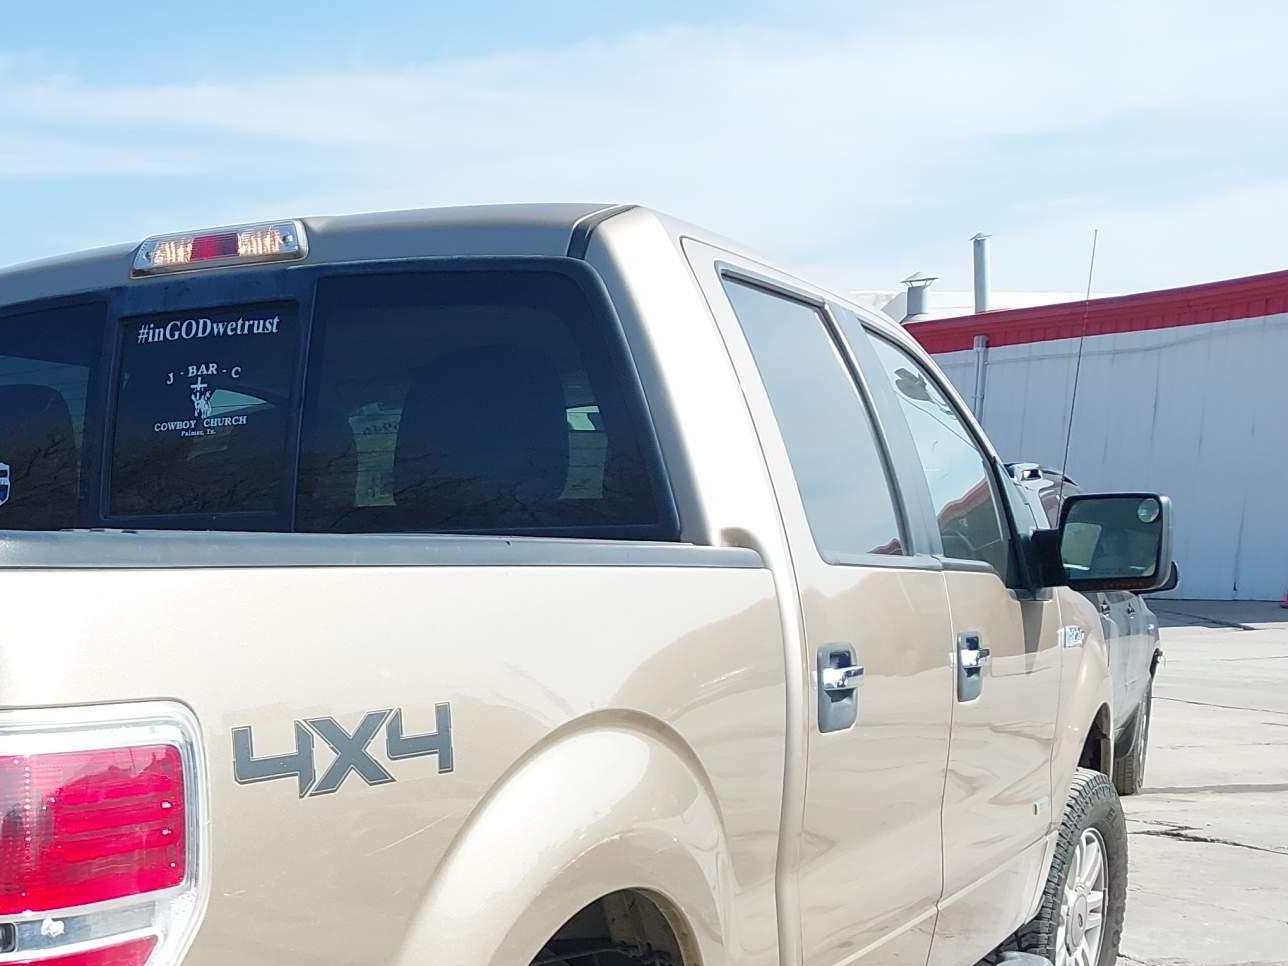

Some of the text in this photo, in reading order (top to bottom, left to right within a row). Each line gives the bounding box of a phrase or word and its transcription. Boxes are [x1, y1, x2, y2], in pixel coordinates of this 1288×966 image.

[137, 315, 279, 343] #inGODwetrust
[166, 372, 174, 384] J
[188, 363, 217, 377] BAR
[231, 366, 241, 378] C
[154, 416, 247, 431] COWBOY CHURCH
